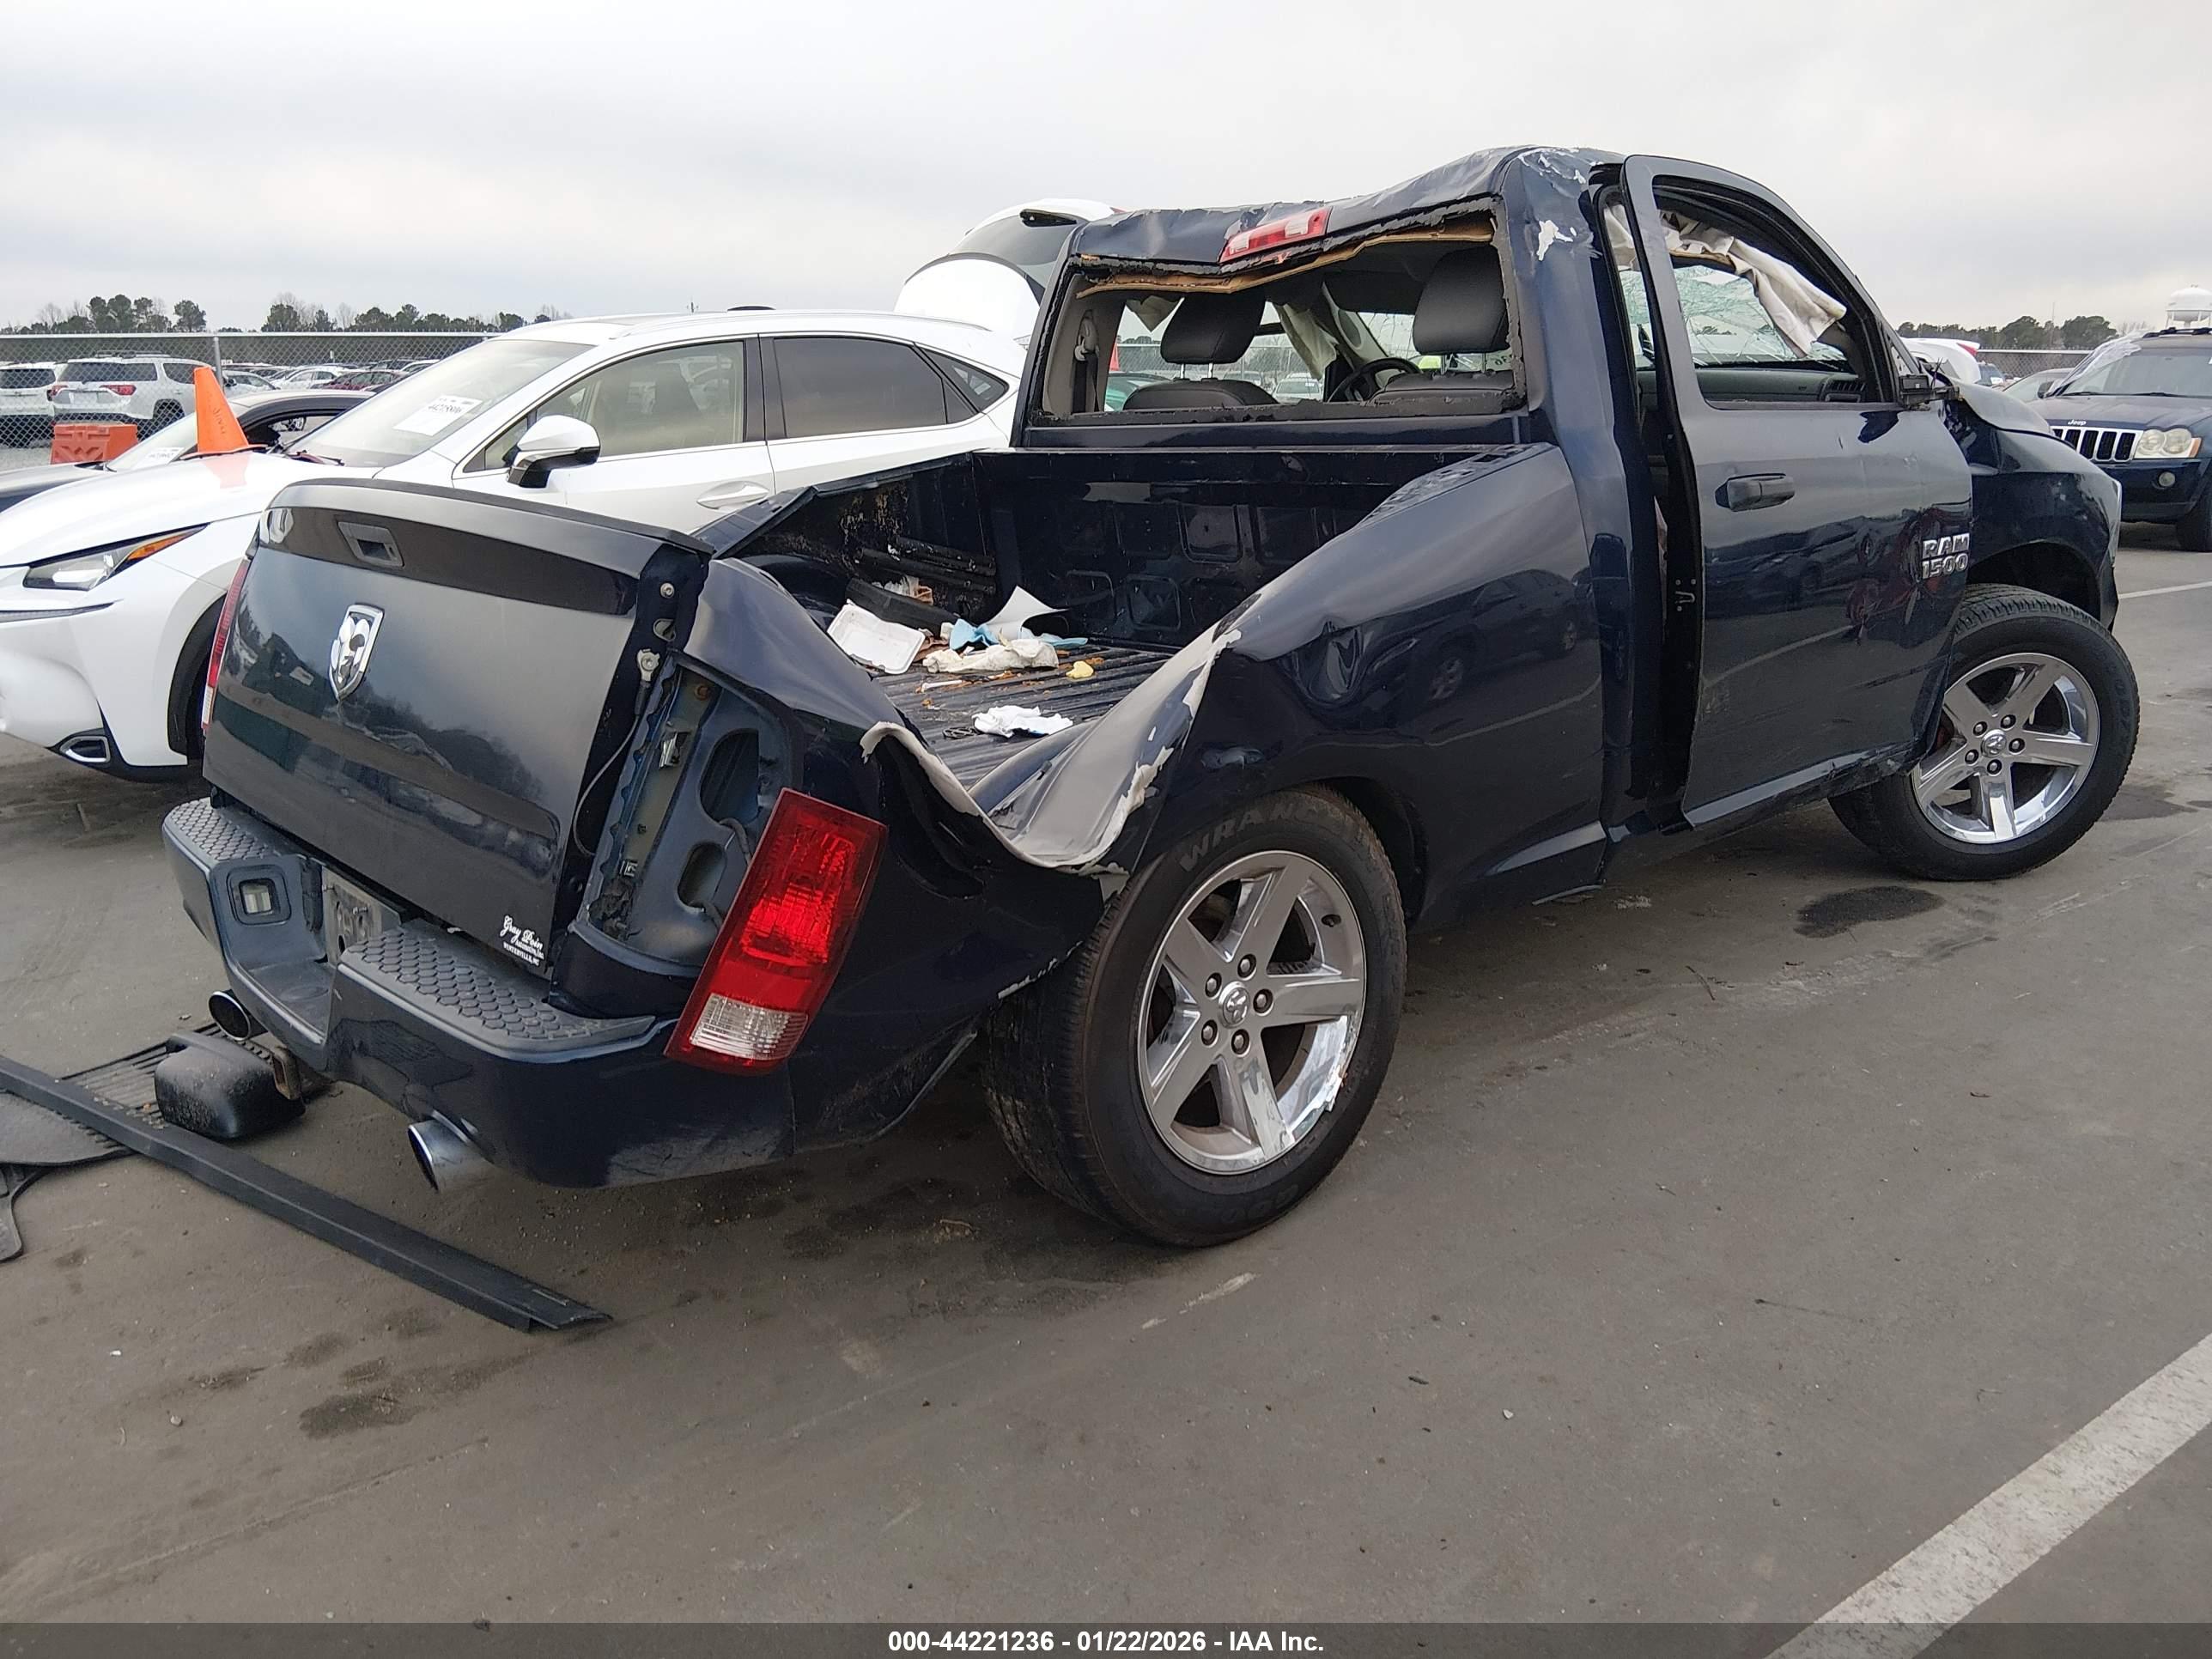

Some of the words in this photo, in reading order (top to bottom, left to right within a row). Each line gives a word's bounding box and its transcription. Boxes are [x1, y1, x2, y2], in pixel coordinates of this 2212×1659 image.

[1923, 533, 1970, 558] RAM
[1923, 553, 1968, 579] 1500
[500, 915, 521, 943] Gray
